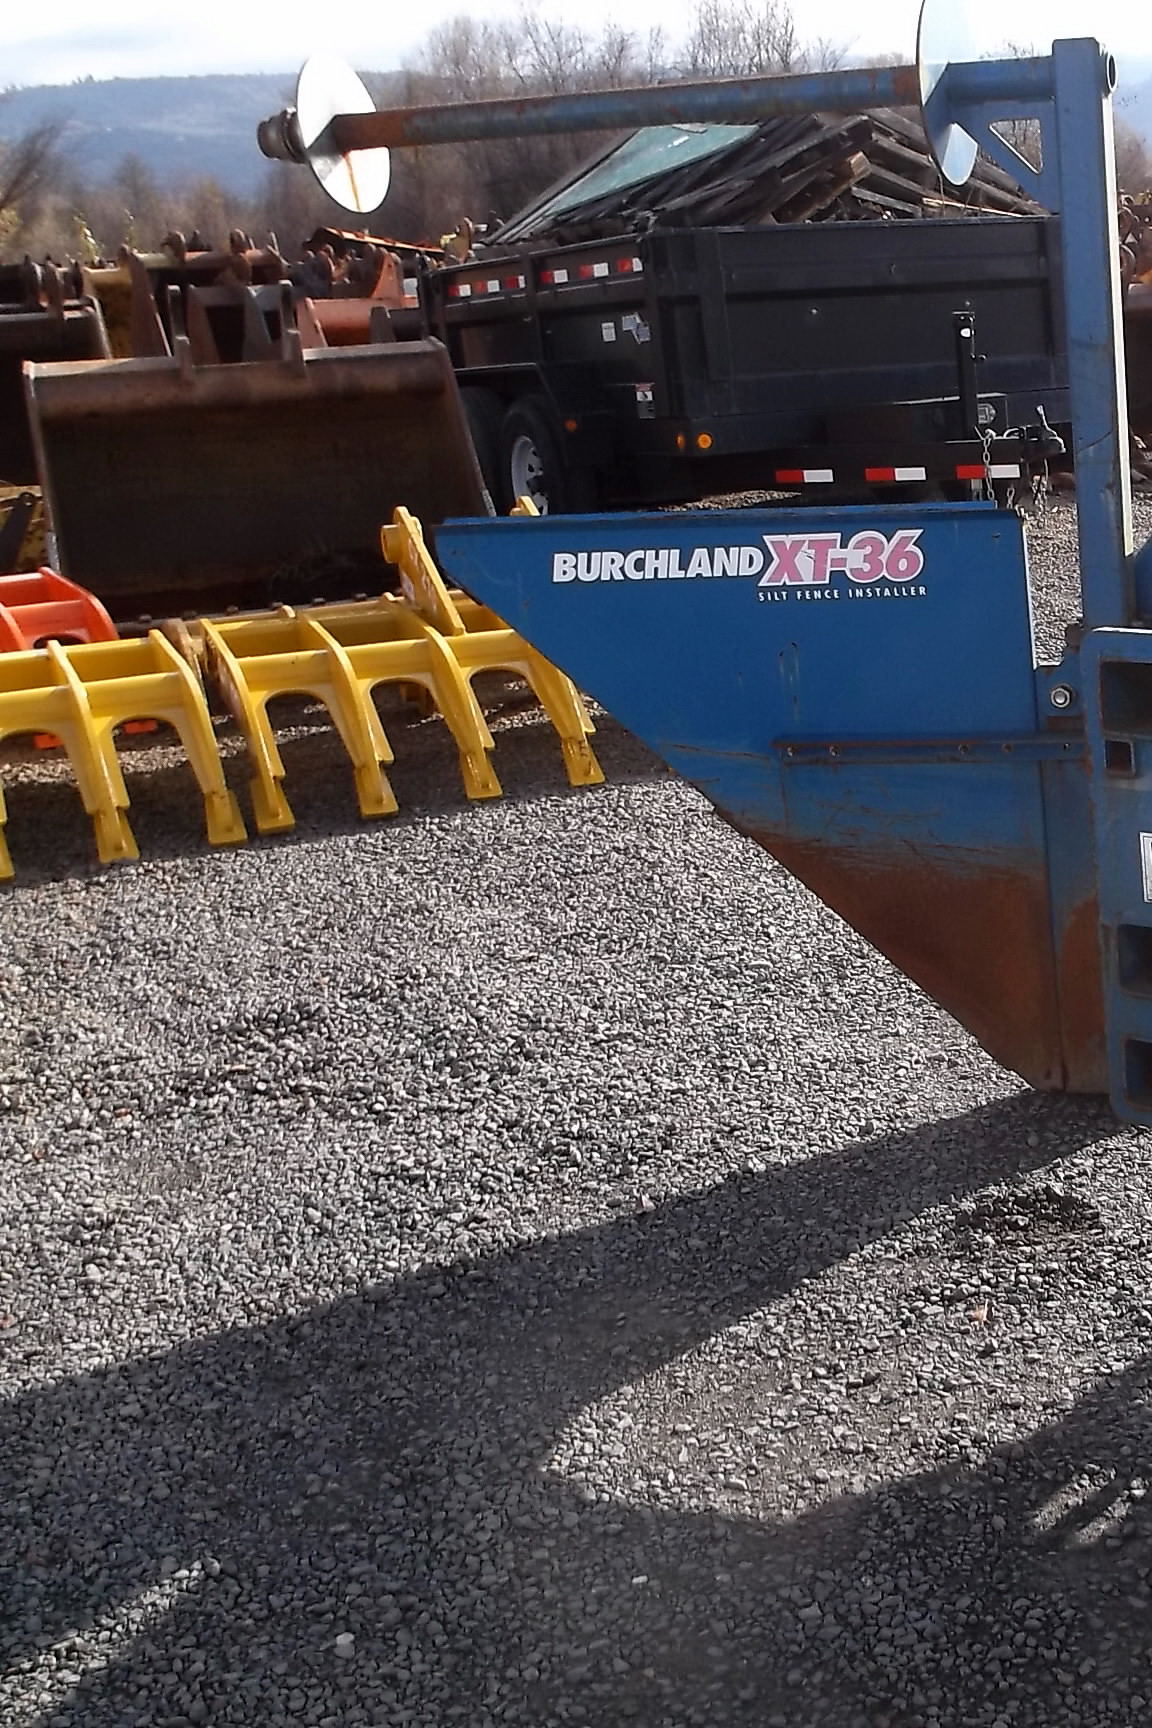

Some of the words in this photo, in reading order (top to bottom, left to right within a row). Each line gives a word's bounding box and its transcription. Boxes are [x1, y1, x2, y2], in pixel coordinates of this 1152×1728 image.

[553, 546, 764, 583] BURCHLAND
[758, 529, 924, 586] XT-36
[758, 591, 788, 602] SILT
[797, 589, 840, 600] FENCE
[848, 586, 927, 599] INSTALLER
